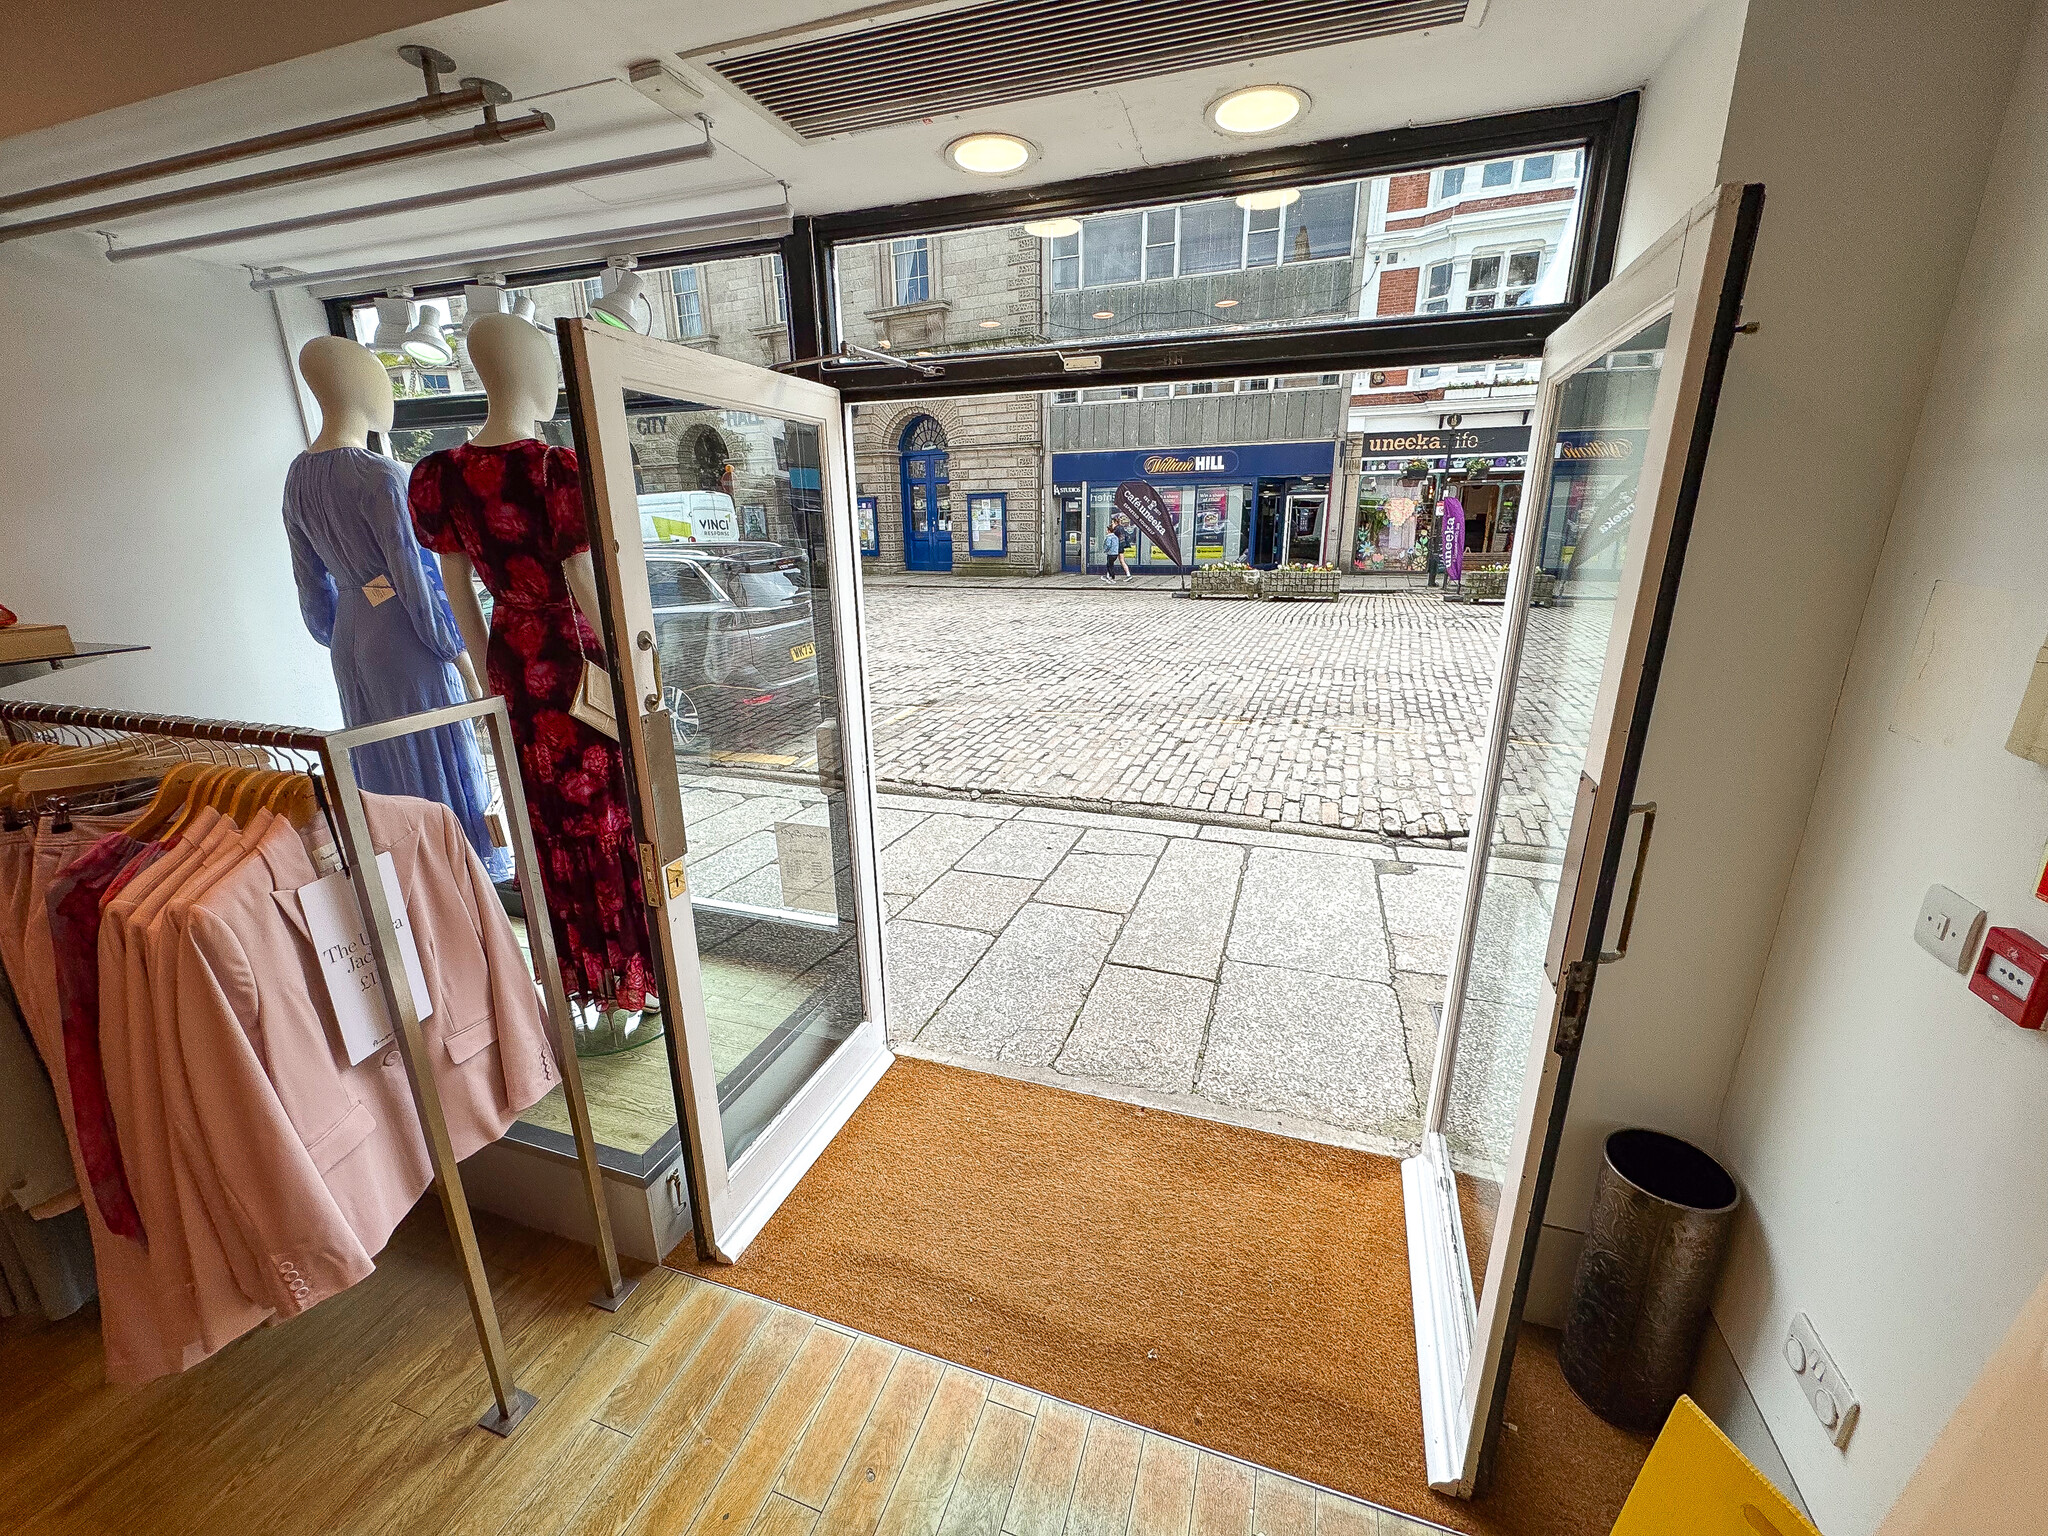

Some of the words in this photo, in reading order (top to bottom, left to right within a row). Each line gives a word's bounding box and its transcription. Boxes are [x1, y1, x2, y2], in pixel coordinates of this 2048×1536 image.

[636, 415, 667, 436] CITY
[1369, 432, 1479, 452] uneeka.ife
[1144, 455, 1195, 474] William
[1195, 456, 1224, 471] HILL
[698, 519, 730, 531] VINCI
[1444, 516, 1456, 568] uneeka
[323, 941, 357, 965] The
